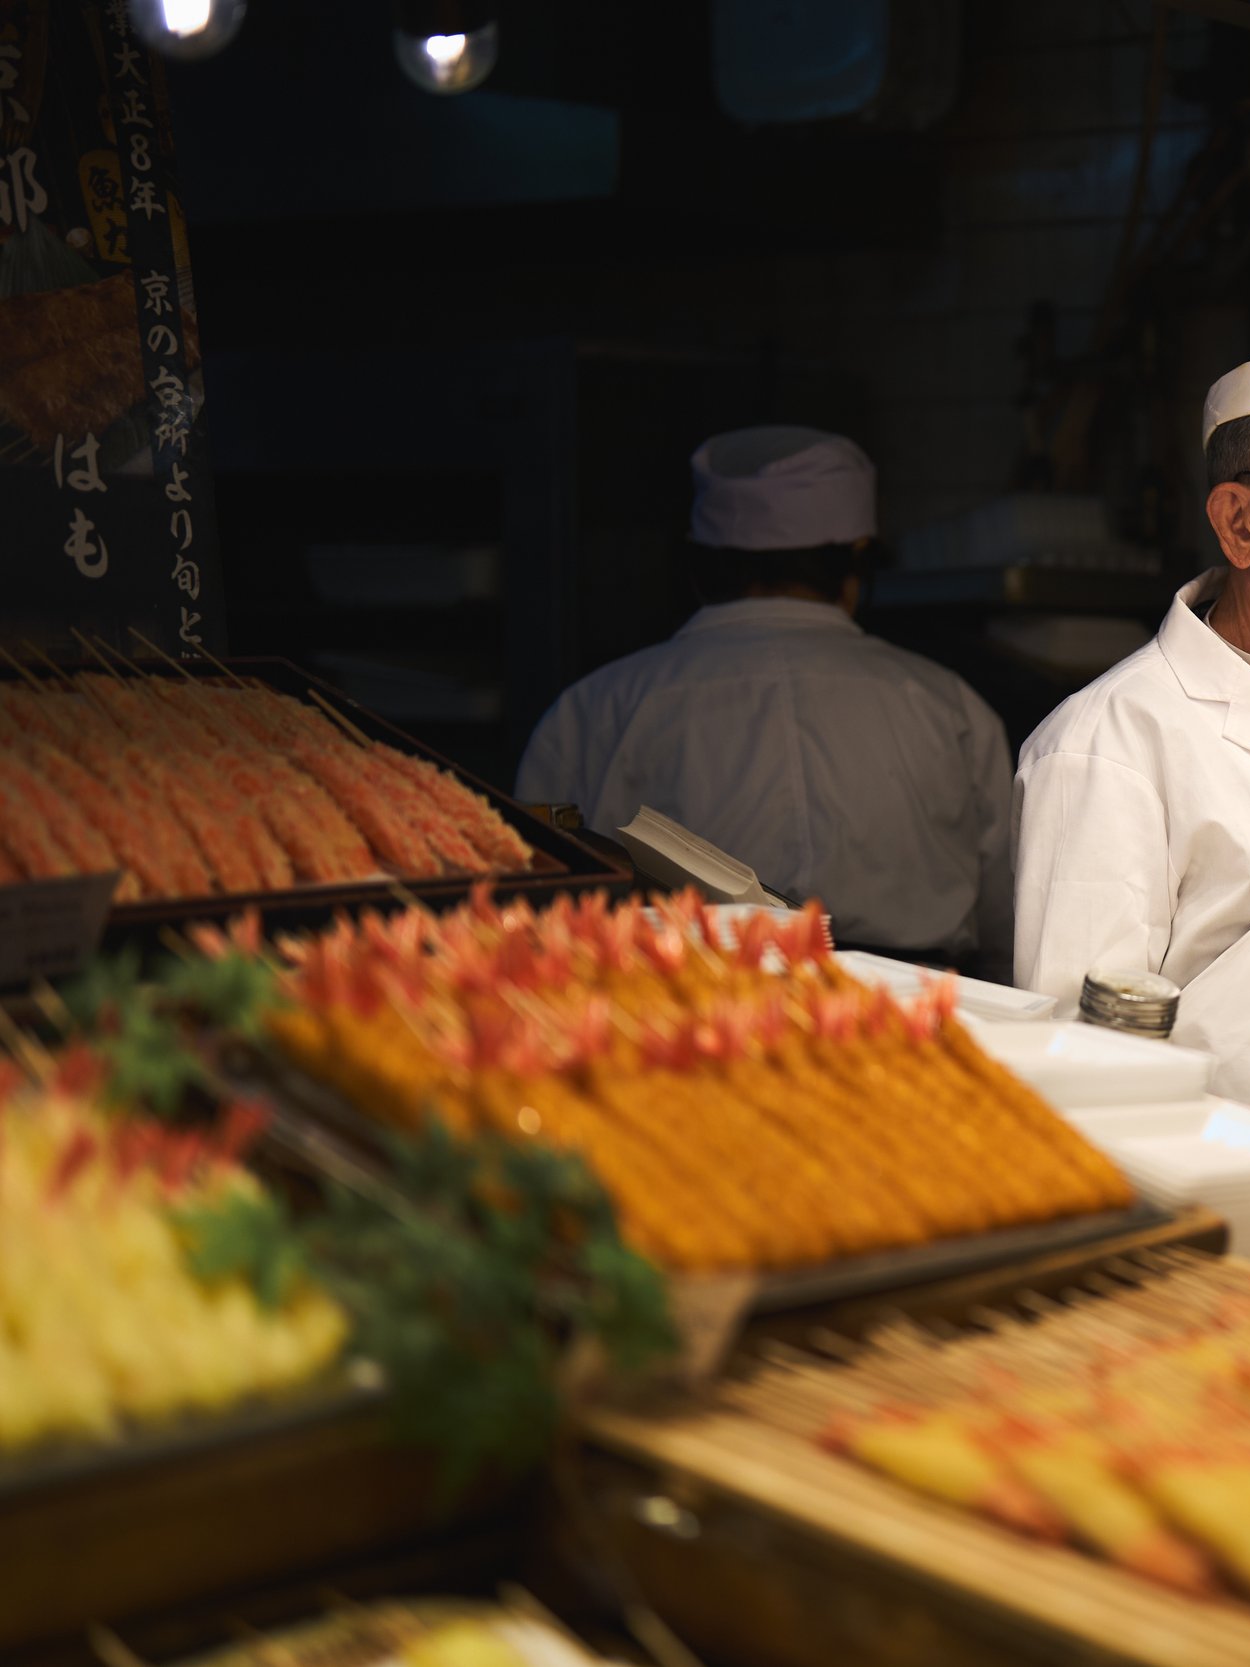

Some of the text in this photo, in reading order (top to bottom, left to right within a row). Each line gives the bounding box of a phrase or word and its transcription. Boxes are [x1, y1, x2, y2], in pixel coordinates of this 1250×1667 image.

[54, 432, 109, 579] はも
[140, 270, 202, 658] 京の台所より旬と
